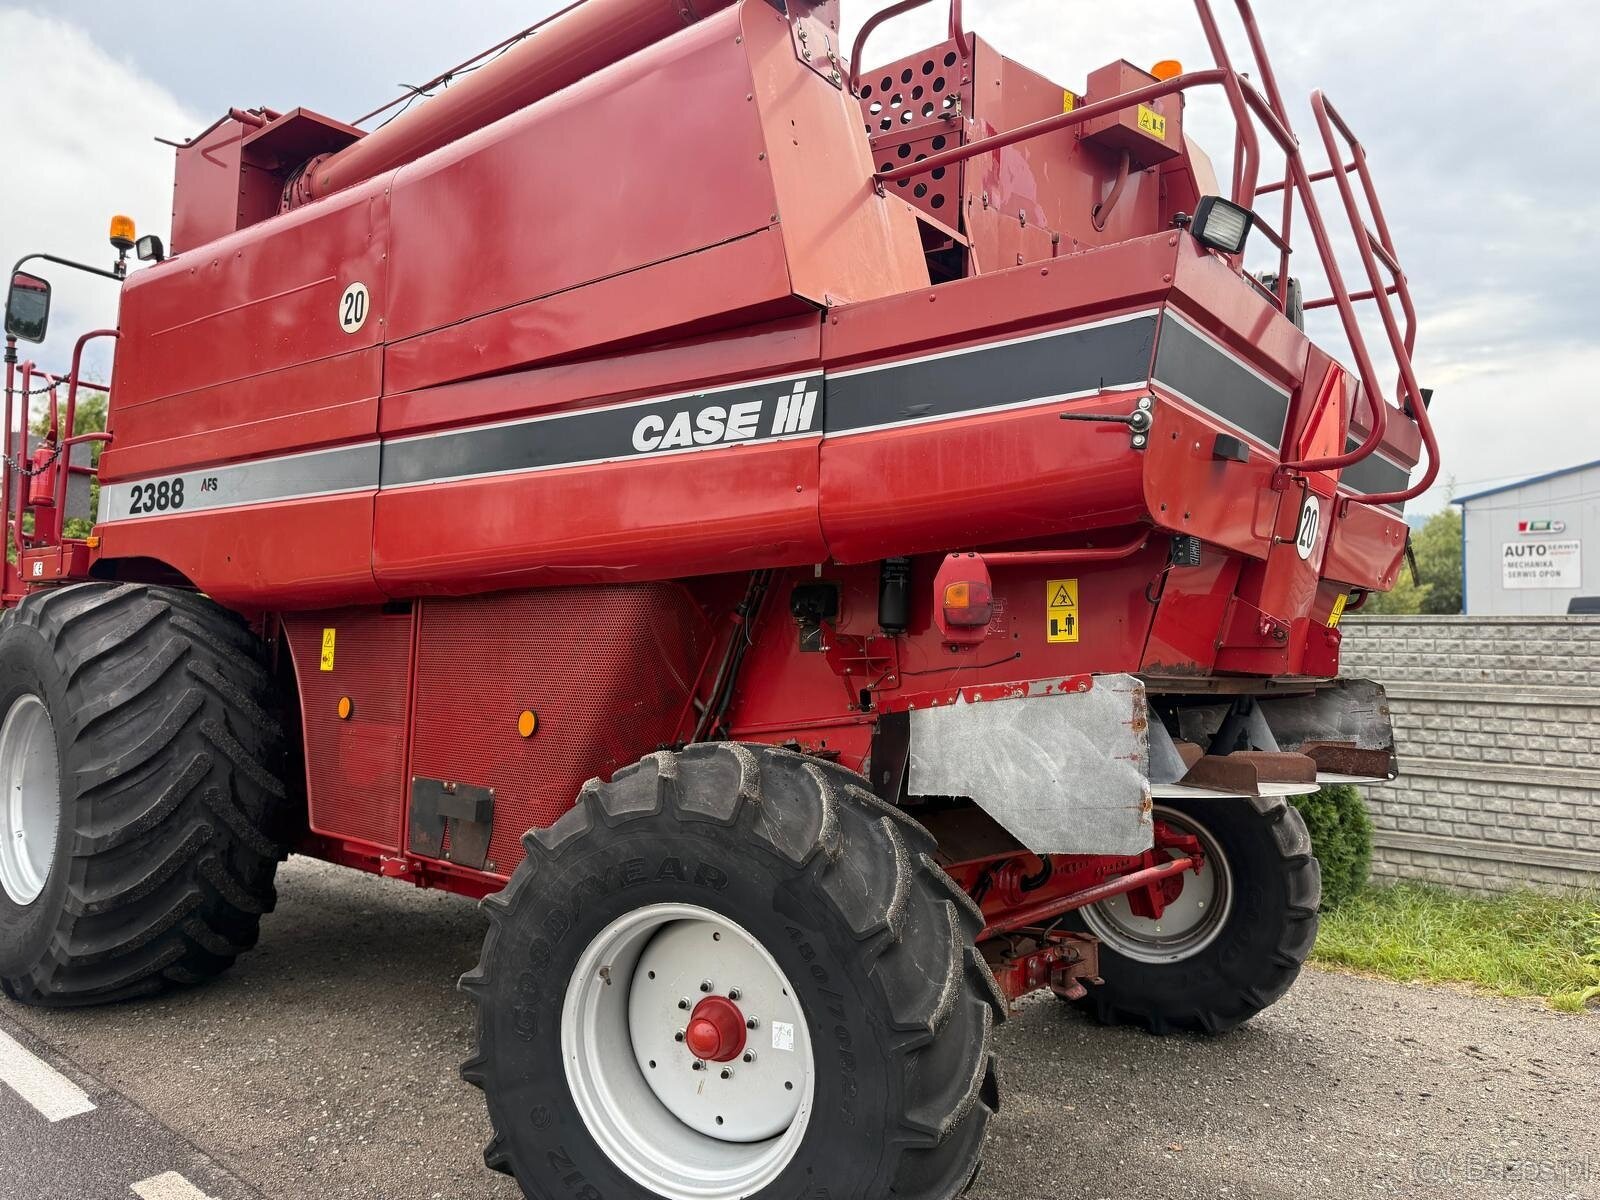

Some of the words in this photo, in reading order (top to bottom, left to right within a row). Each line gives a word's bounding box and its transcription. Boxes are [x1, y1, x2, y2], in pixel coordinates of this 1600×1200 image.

[344, 291, 364, 325] 20
[631, 400, 763, 452] CASE
[129, 477, 185, 515] 2388
[201, 477, 218, 492] AFS
[1299, 505, 1317, 549] 20
[1504, 544, 1547, 558] AUTO
[1539, 570, 1561, 578] OPON
